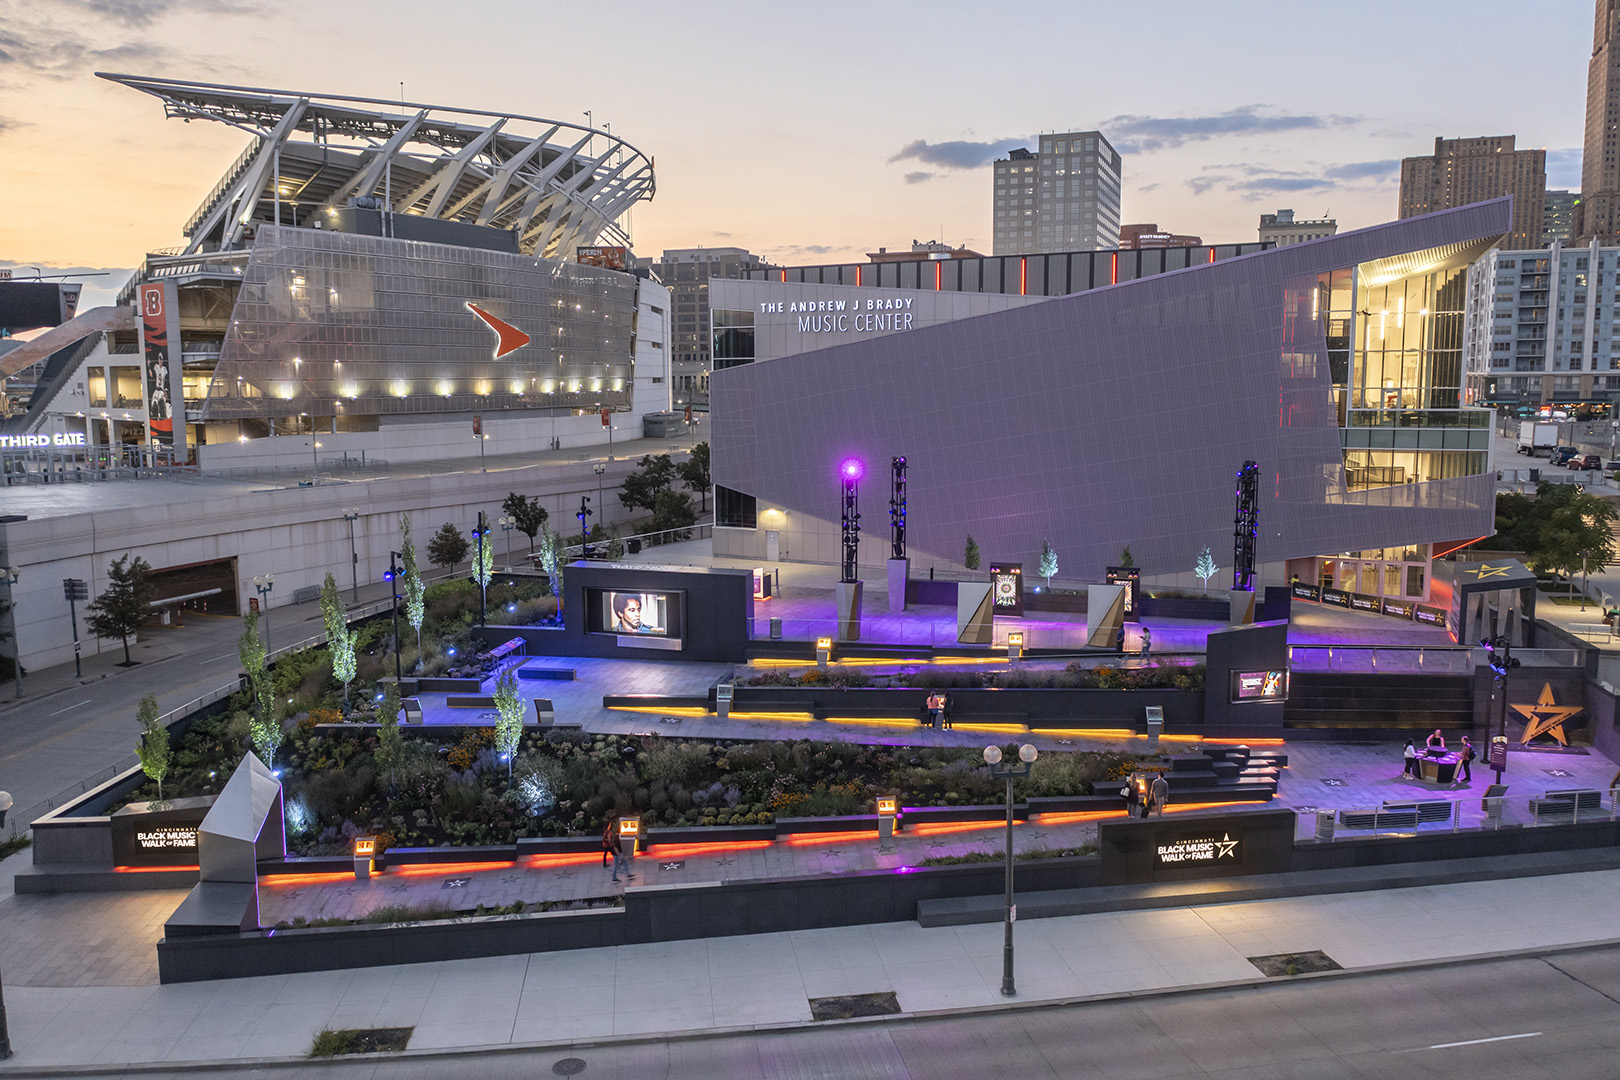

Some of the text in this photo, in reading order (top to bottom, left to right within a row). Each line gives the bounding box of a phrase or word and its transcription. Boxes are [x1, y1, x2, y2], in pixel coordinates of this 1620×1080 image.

[761, 298, 913, 313] THE ANDREW J BRADY
[798, 313, 913, 333] MUSIC CENTER
[124, 428, 145, 436] PIZZ
[0, 432, 85, 448] THIRD GATE
[137, 831, 196, 840] BLACK MUSIC
[141, 840, 166, 848] WALK
[173, 839, 196, 847] FAME
[1157, 842, 1214, 855] BLACK MUSIC
[1161, 853, 1185, 862] WALK
[1191, 850, 1214, 860] FAME
